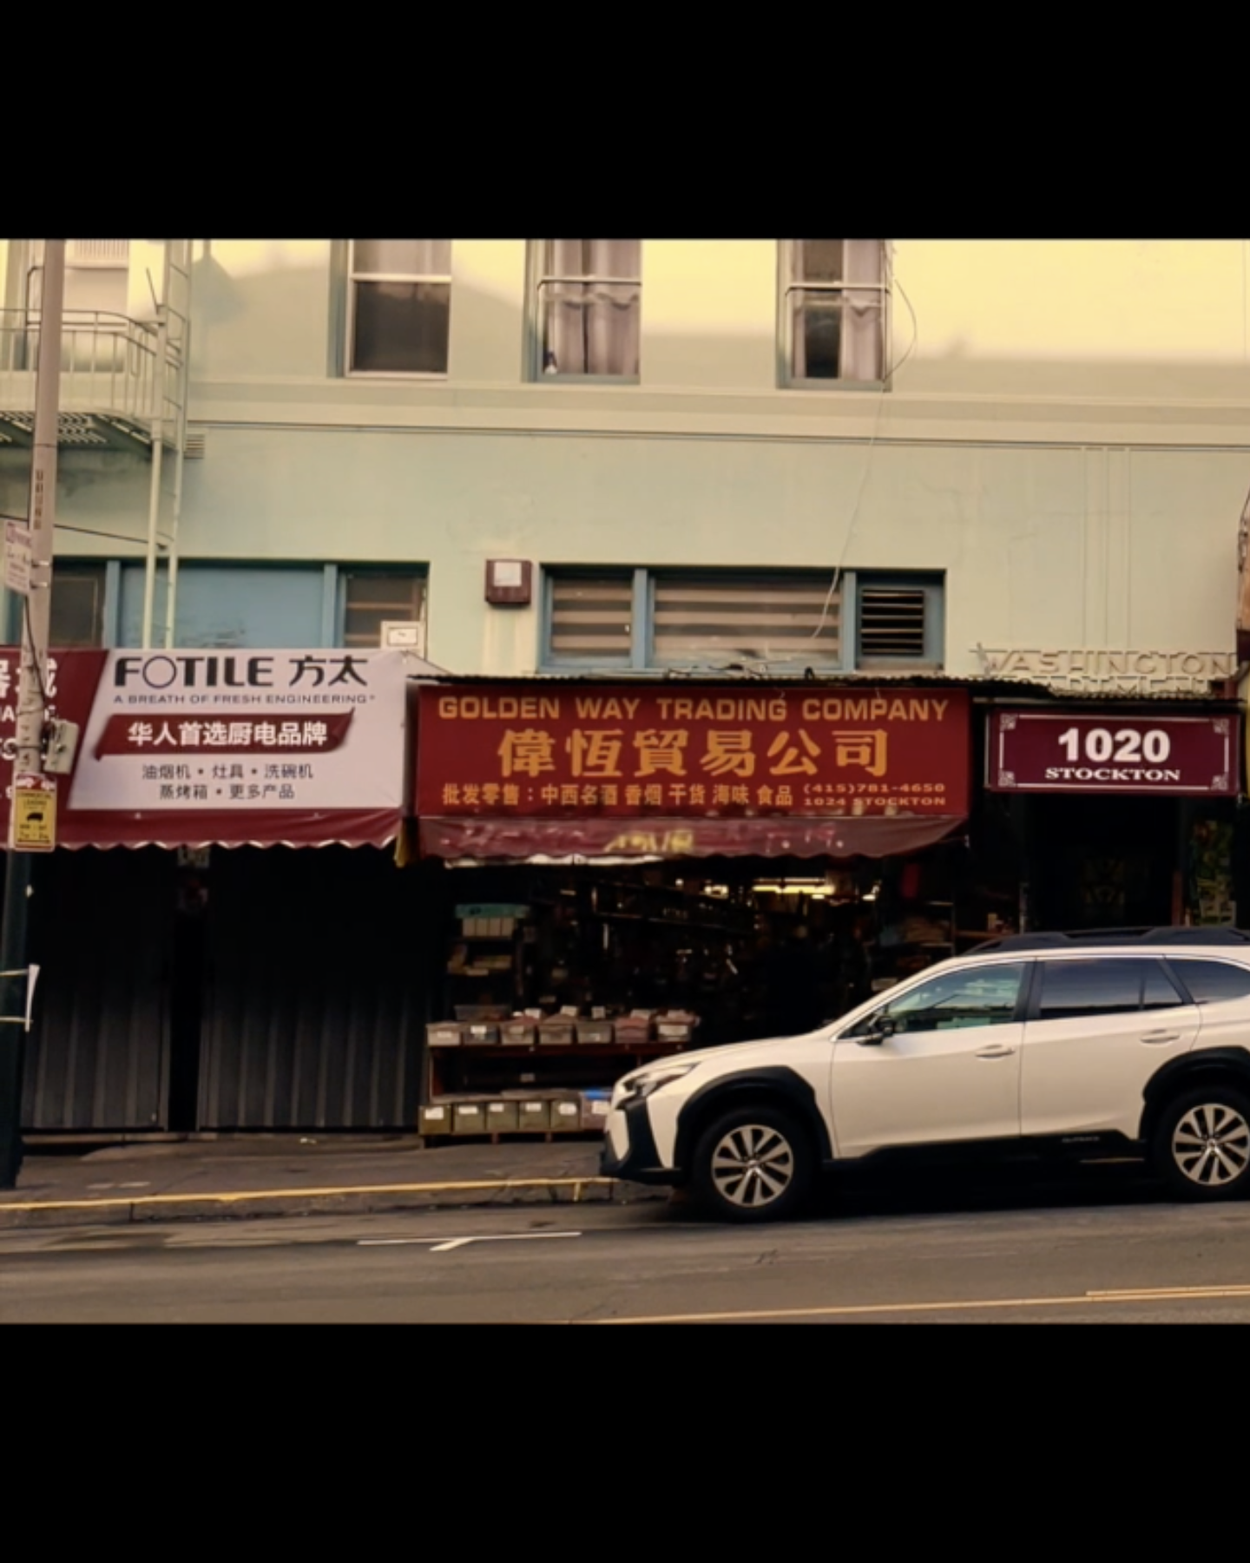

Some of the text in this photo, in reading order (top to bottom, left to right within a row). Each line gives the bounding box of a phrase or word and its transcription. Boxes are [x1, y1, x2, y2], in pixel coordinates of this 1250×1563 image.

[114, 655, 275, 689] FOTILE
[289, 655, 369, 688] 方太
[114, 695, 124, 705] A
[128, 695, 185, 705] BREATH
[190, 695, 209, 705] OF
[214, 695, 262, 705] FRESH
[438, 697, 949, 722] GOLDEN WAY TRADING COMPANY
[128, 722, 328, 747] 华人首选厨电品牌
[1058, 728, 1171, 763] 1020
[142, 764, 313, 780] 油烟机 灶具 洗碗机
[1045, 768, 1181, 782] STOCKTON
[160, 784, 295, 800] 蒸烤箱 更多产品
[803, 783, 946, 796] (415)781-4650
[804, 797, 946, 807] 1024 STOCKTON
